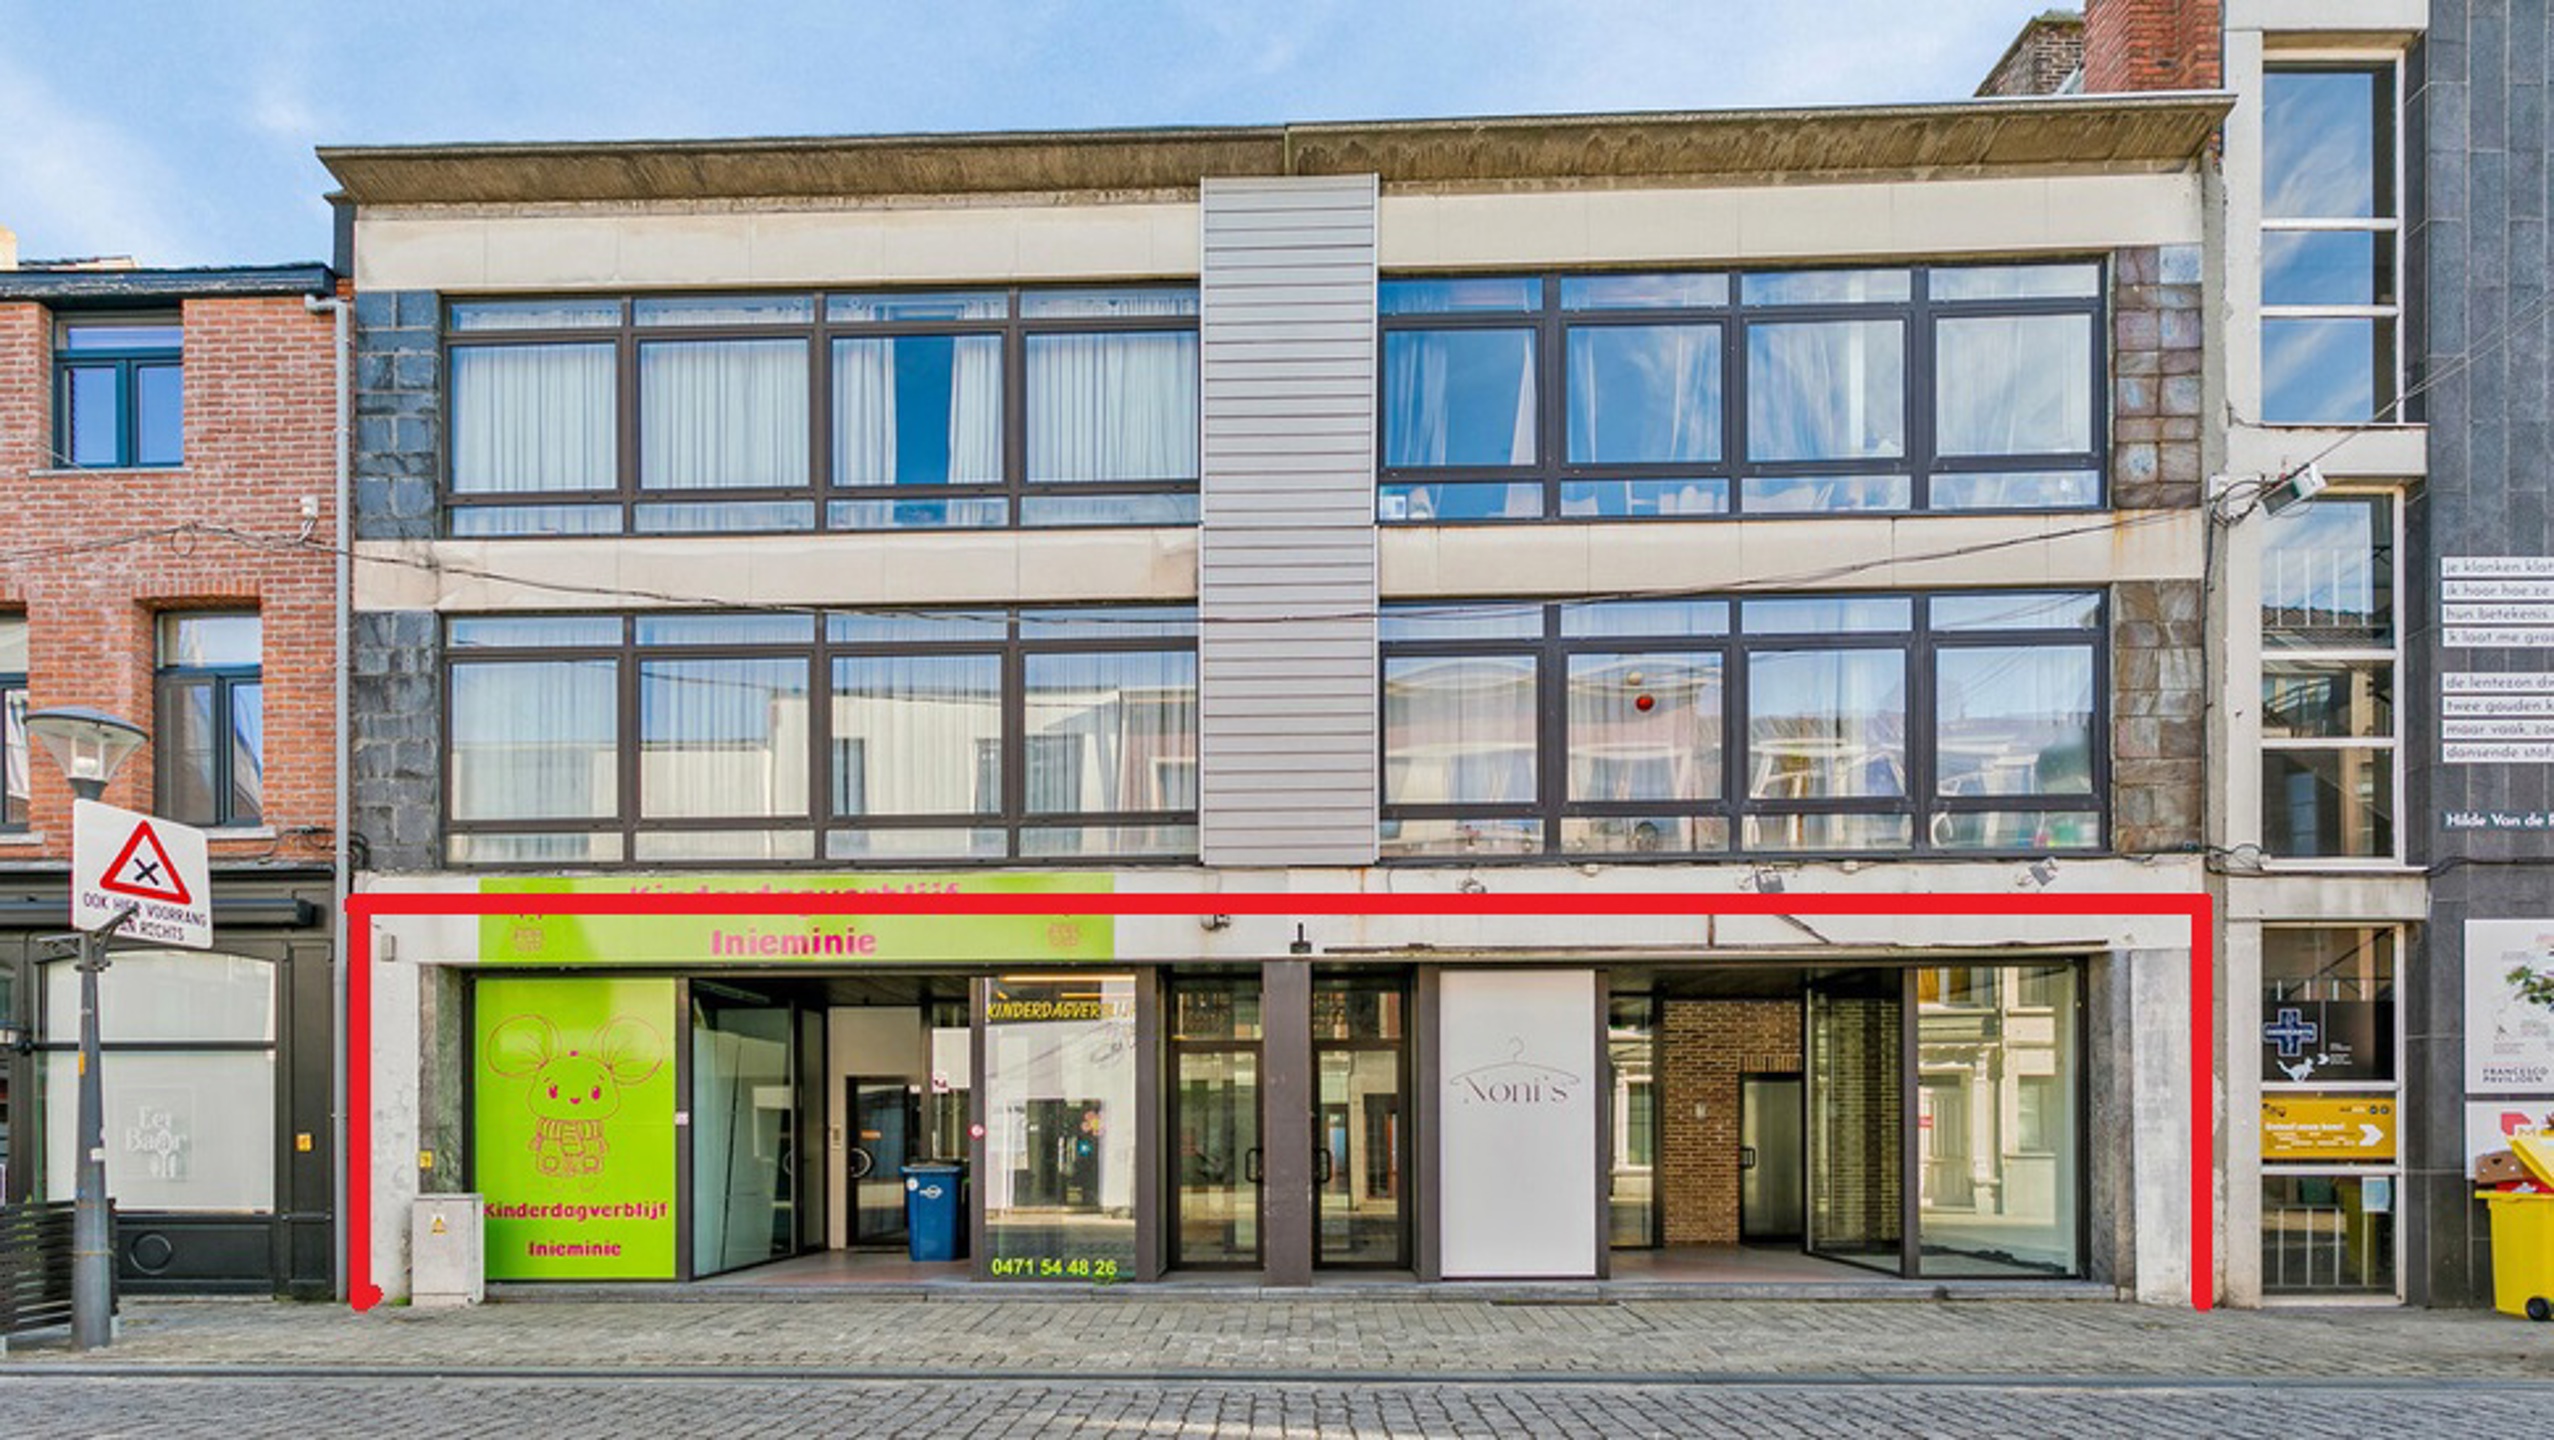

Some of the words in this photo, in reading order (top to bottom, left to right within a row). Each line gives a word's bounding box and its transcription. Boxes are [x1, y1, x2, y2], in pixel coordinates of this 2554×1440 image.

[2445, 560, 2458, 575] je
[2464, 559, 2520, 573] klanken
[2446, 582, 2458, 596] ik
[2464, 582, 2497, 597] hoor
[2501, 582, 2529, 597] hoe
[2446, 606, 2473, 620] hun
[2478, 606, 2549, 620] betekenis
[2462, 630, 2493, 642] laat
[2496, 634, 2519, 642] me
[2446, 675, 2465, 689] de
[2469, 675, 2532, 689] lentezon
[2447, 700, 2481, 711] twee
[2485, 699, 2541, 714] gouden
[2446, 725, 2484, 735] maar
[2446, 746, 2519, 758] dansende
[2446, 812, 2486, 827] Hilde
[2490, 812, 2521, 827] Van
[2524, 812, 2545, 827] de
[83, 891, 109, 910] OOK
[145, 903, 207, 928] VOORRANG
[140, 920, 185, 941] RECHTS
[710, 927, 877, 956] Inieminie
[1463, 1076, 1568, 1103] Noni's
[483, 1201, 667, 1224] Kinderdagverblijf
[528, 1240, 621, 1257] Inieminie
[991, 1258, 1035, 1276] 0471
[1040, 1258, 1063, 1276] 54
[1066, 1258, 1089, 1276] 48
[1094, 1258, 1117, 1277] 26
